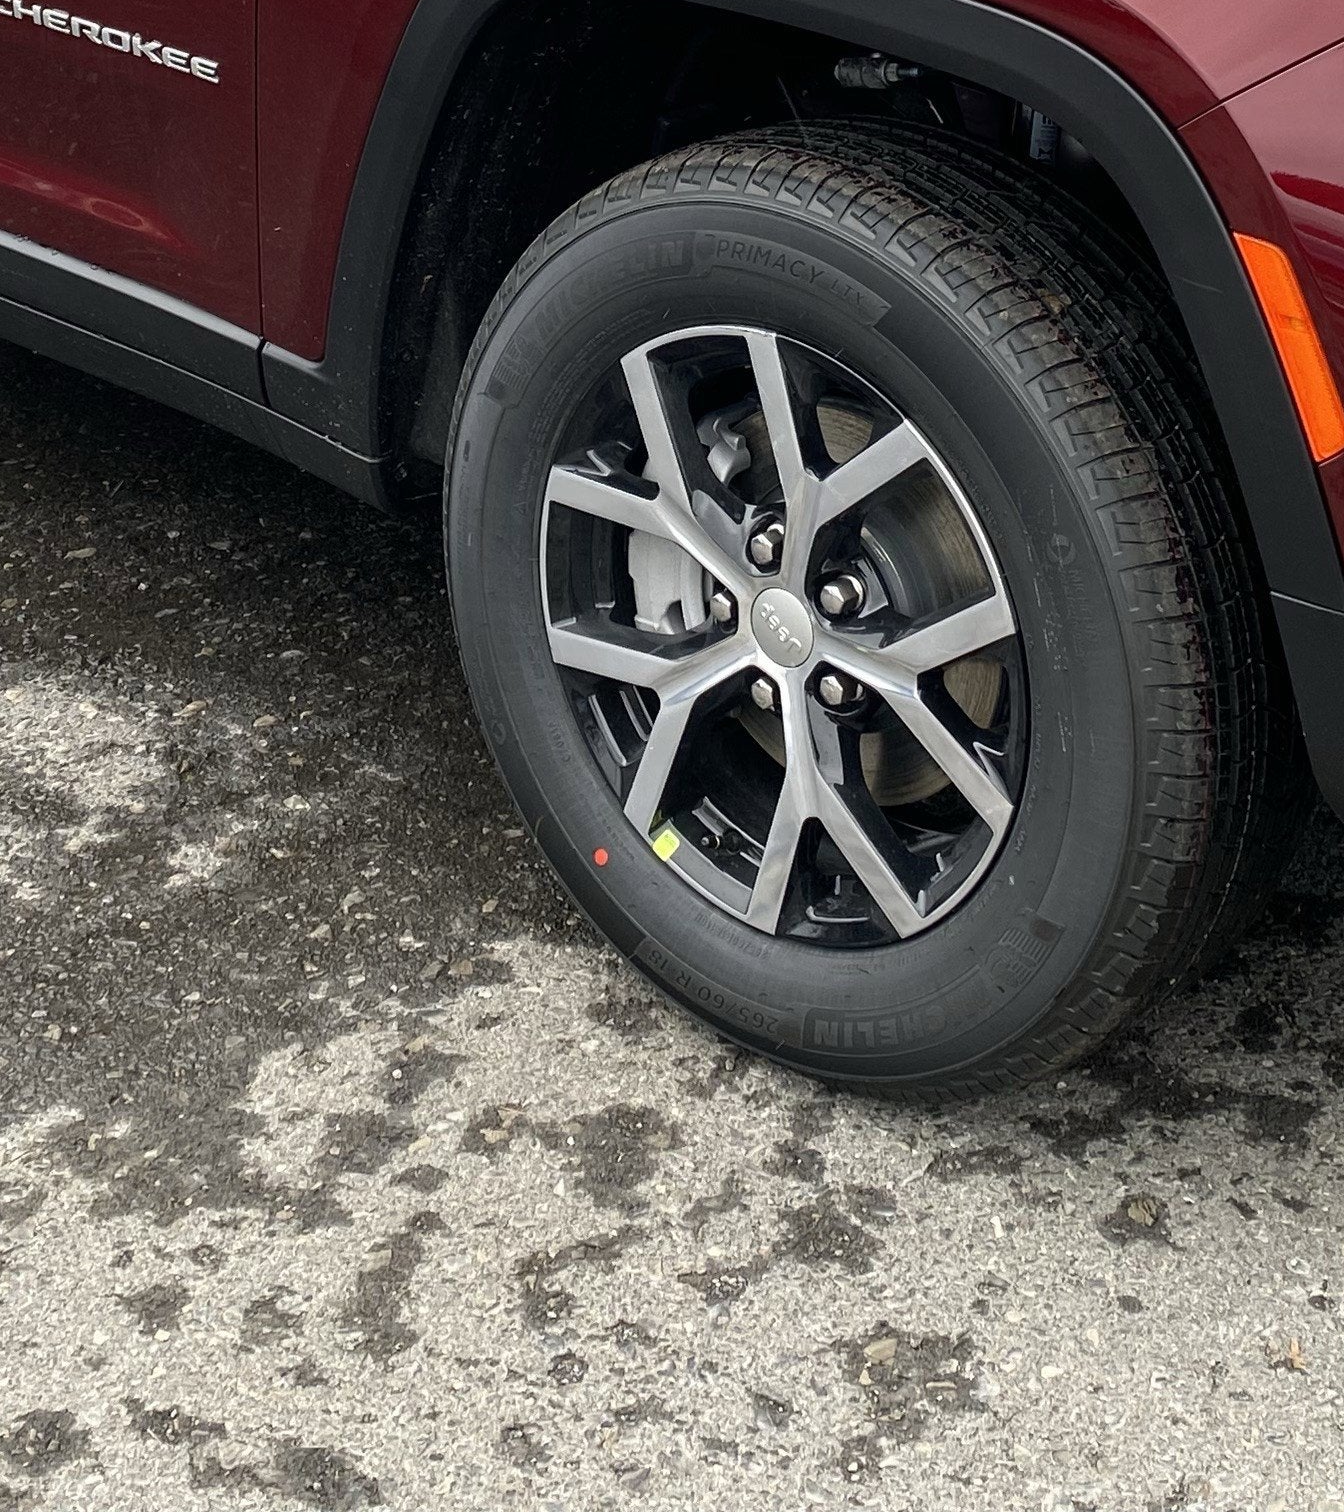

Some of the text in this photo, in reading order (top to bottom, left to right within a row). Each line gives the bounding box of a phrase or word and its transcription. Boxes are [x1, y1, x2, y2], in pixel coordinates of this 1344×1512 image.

[716, 239, 825, 285] PRIMACY
[647, 948, 779, 1035] 265/60 R 18
